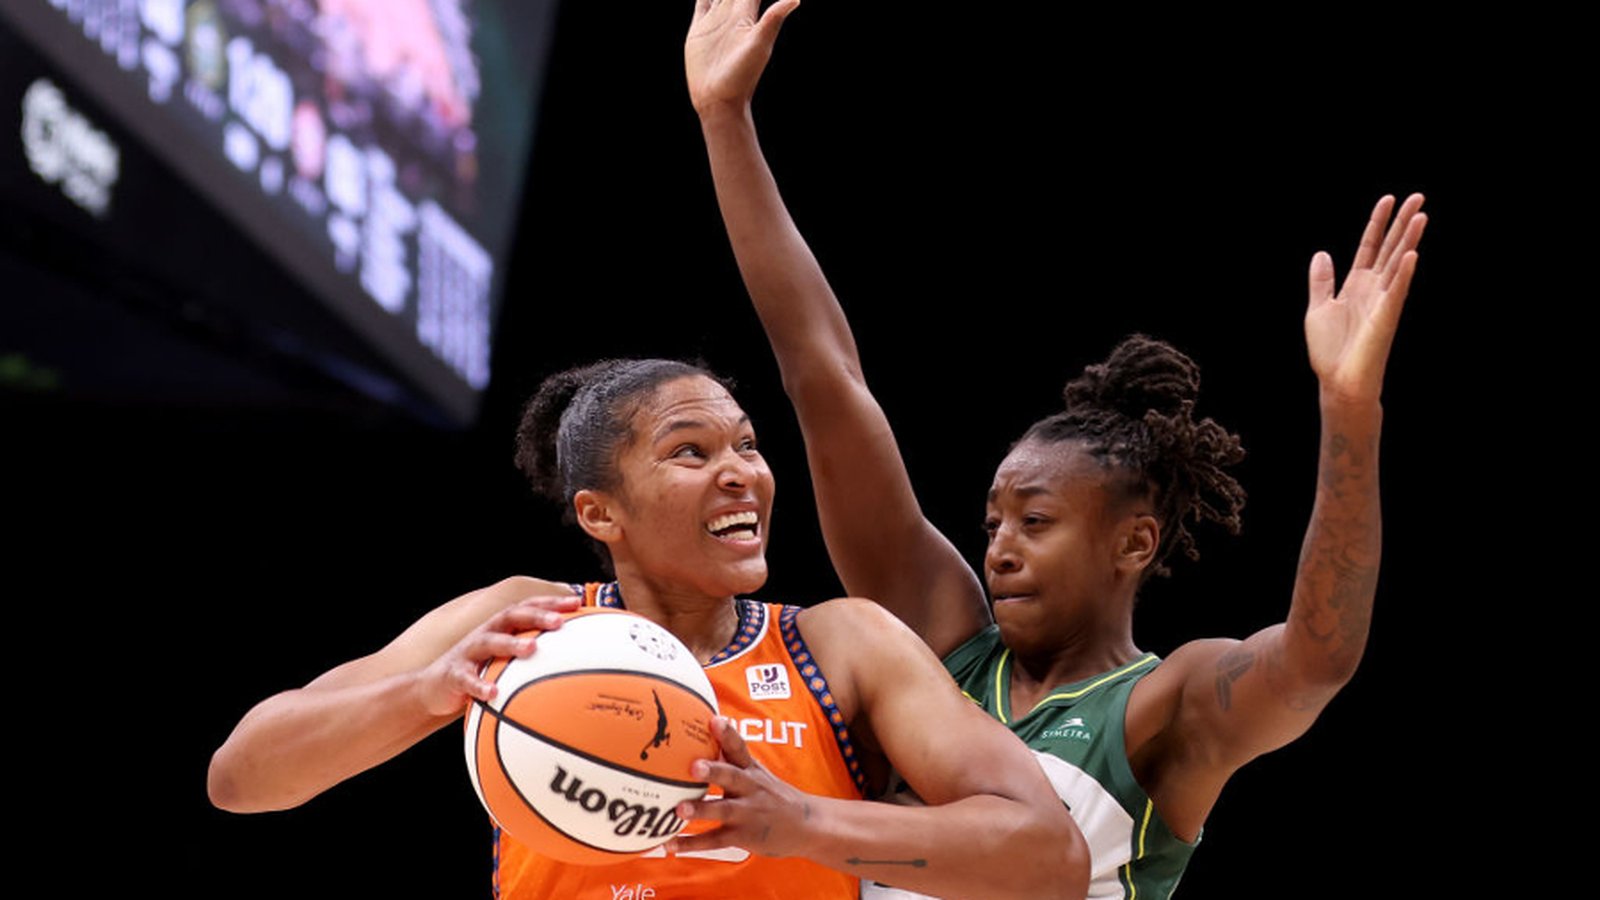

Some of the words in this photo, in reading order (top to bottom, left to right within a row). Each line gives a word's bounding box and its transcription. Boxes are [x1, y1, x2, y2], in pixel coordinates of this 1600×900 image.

[750, 681, 787, 693] Post
[1041, 730, 1091, 740] SYMETRA
[550, 766, 684, 839] Wilson
[610, 883, 656, 900] Yale
